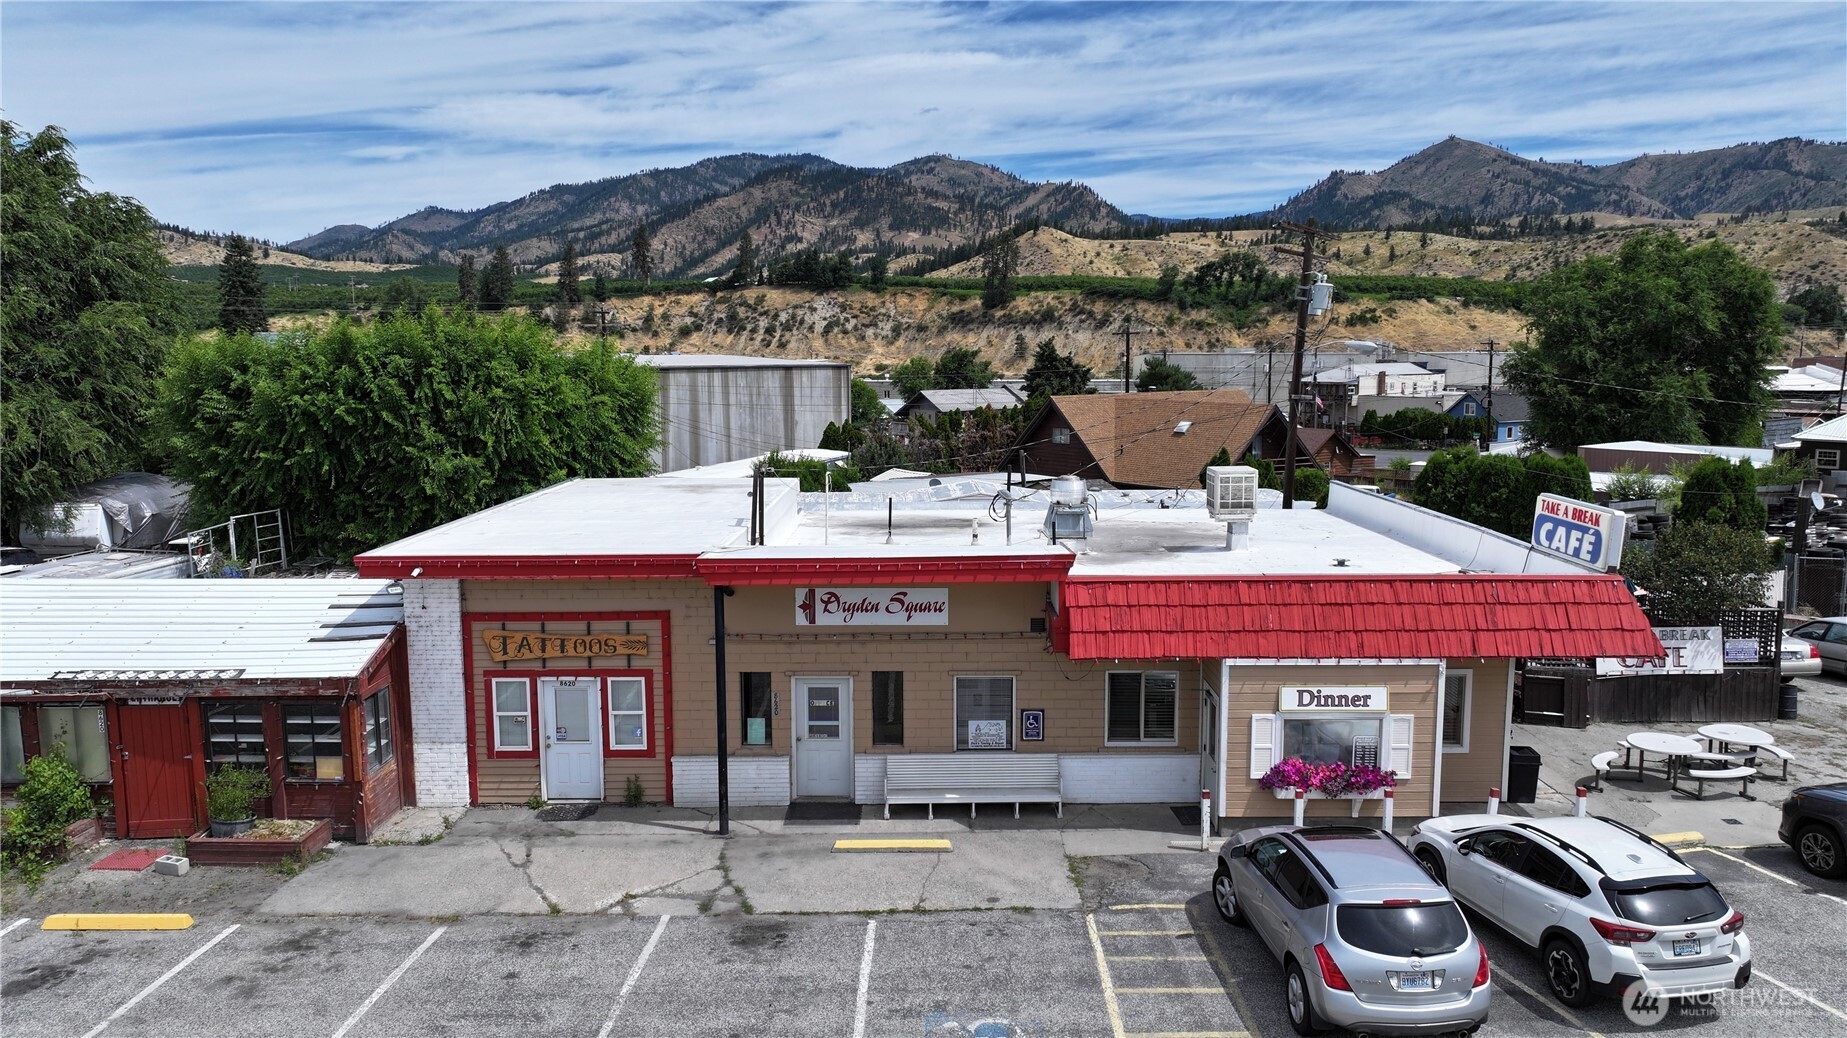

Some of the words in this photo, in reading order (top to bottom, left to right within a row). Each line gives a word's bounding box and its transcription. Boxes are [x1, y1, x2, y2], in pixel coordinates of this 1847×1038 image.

[1541, 499, 1561, 516] TAKE
[1562, 505, 1569, 519] A
[1571, 507, 1601, 527] BREAK
[1540, 521, 1596, 561] CAFÉ
[820, 591, 881, 623] Dryden
[885, 591, 945, 622] Square
[488, 635, 617, 659] TATTOOS
[1659, 629, 1711, 641] BREAK
[559, 680, 576, 688] 8620
[1296, 689, 1371, 708] Dinner
